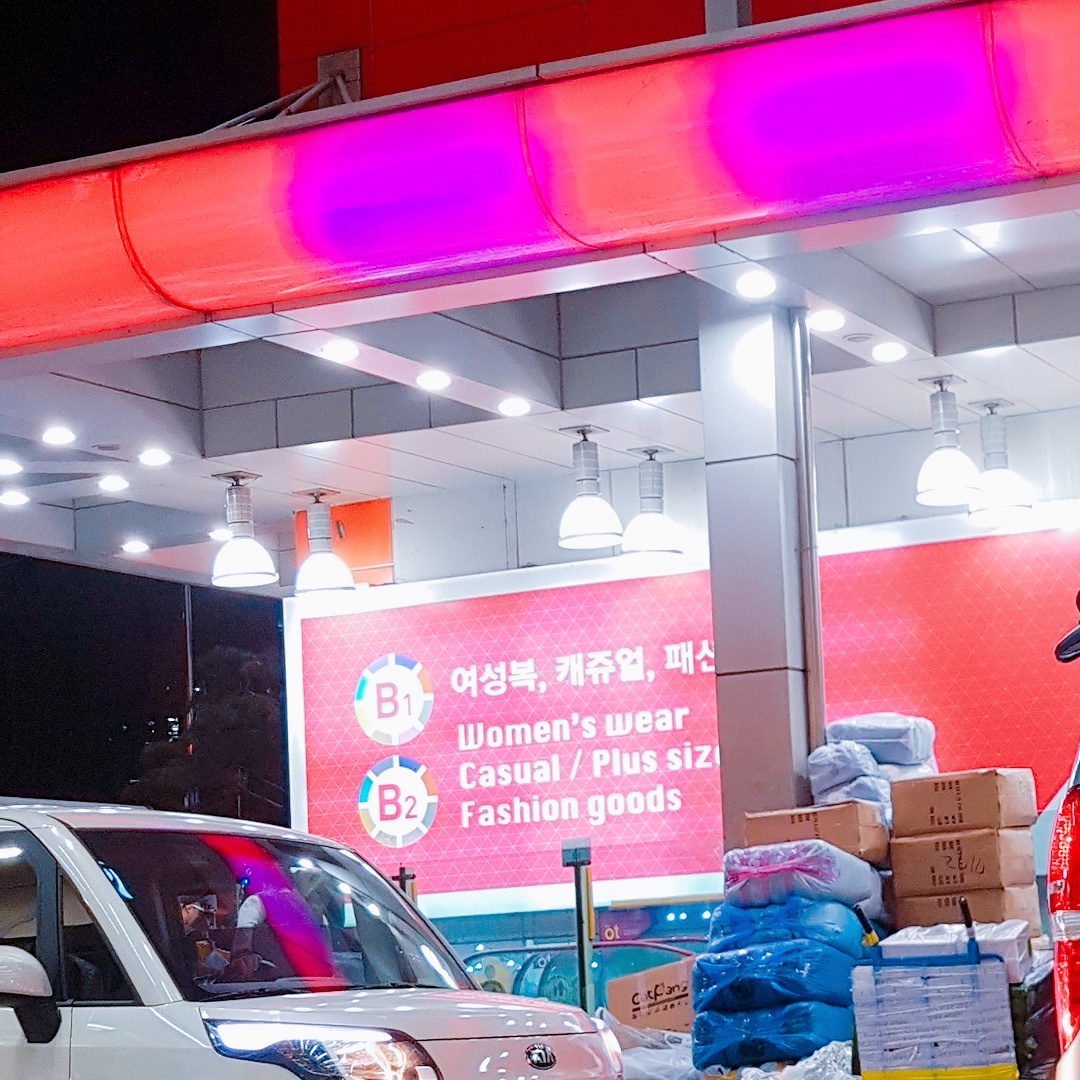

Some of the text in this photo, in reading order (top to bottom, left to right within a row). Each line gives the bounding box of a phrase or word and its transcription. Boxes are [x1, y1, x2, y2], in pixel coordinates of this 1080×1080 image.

[451, 659, 547, 698] 여성복,
[556, 646, 655, 687] 캐쥬얼,
[376, 682, 414, 718] B1
[458, 706, 690, 751] Women's wear
[459, 754, 561, 790] Casual
[593, 746, 658, 778] Plus
[667, 742, 720, 771] siz
[378, 784, 418, 822] B2
[460, 784, 683, 828] Fashion goods
